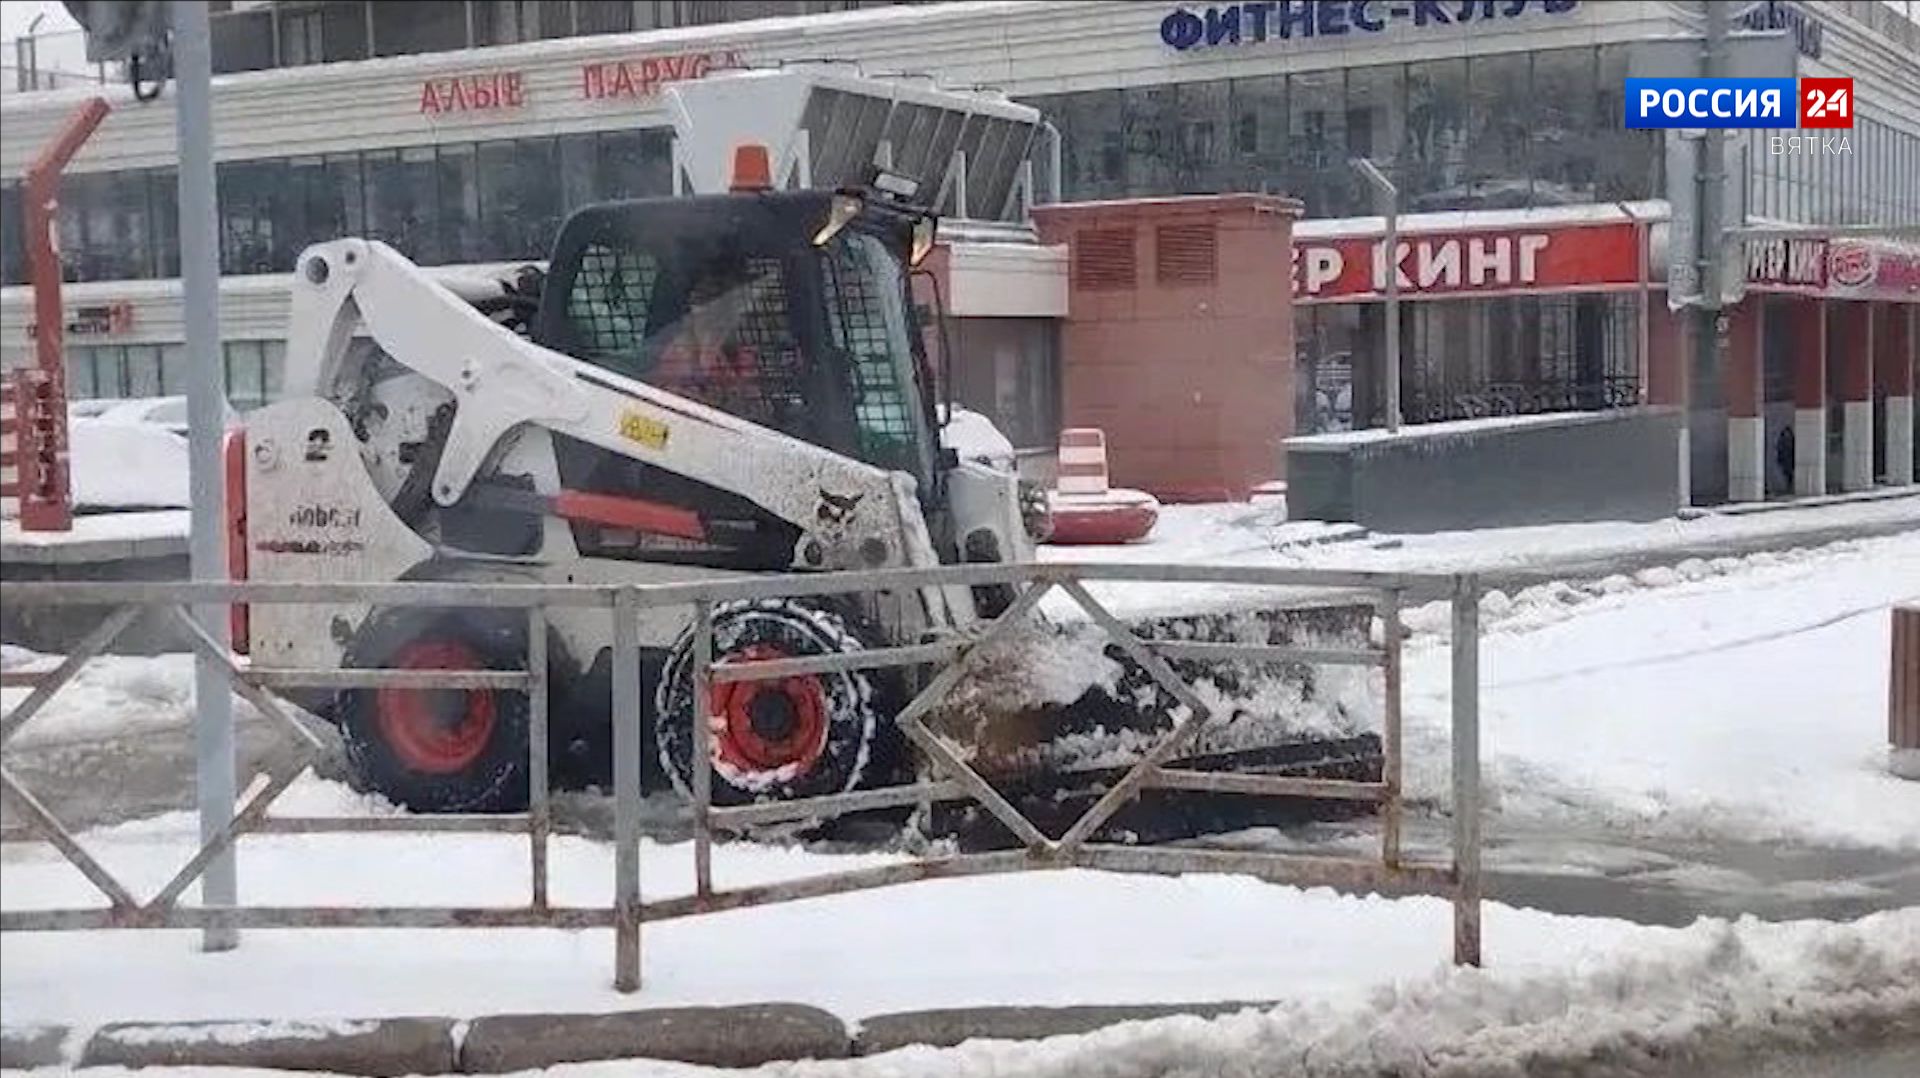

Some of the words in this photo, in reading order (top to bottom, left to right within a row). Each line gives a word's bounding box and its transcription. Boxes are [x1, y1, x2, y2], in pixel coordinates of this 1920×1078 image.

[419, 71, 524, 114] АЛЫЕ
[1371, 233, 1549, 290] КИНГ
[305, 428, 331, 462] 2
